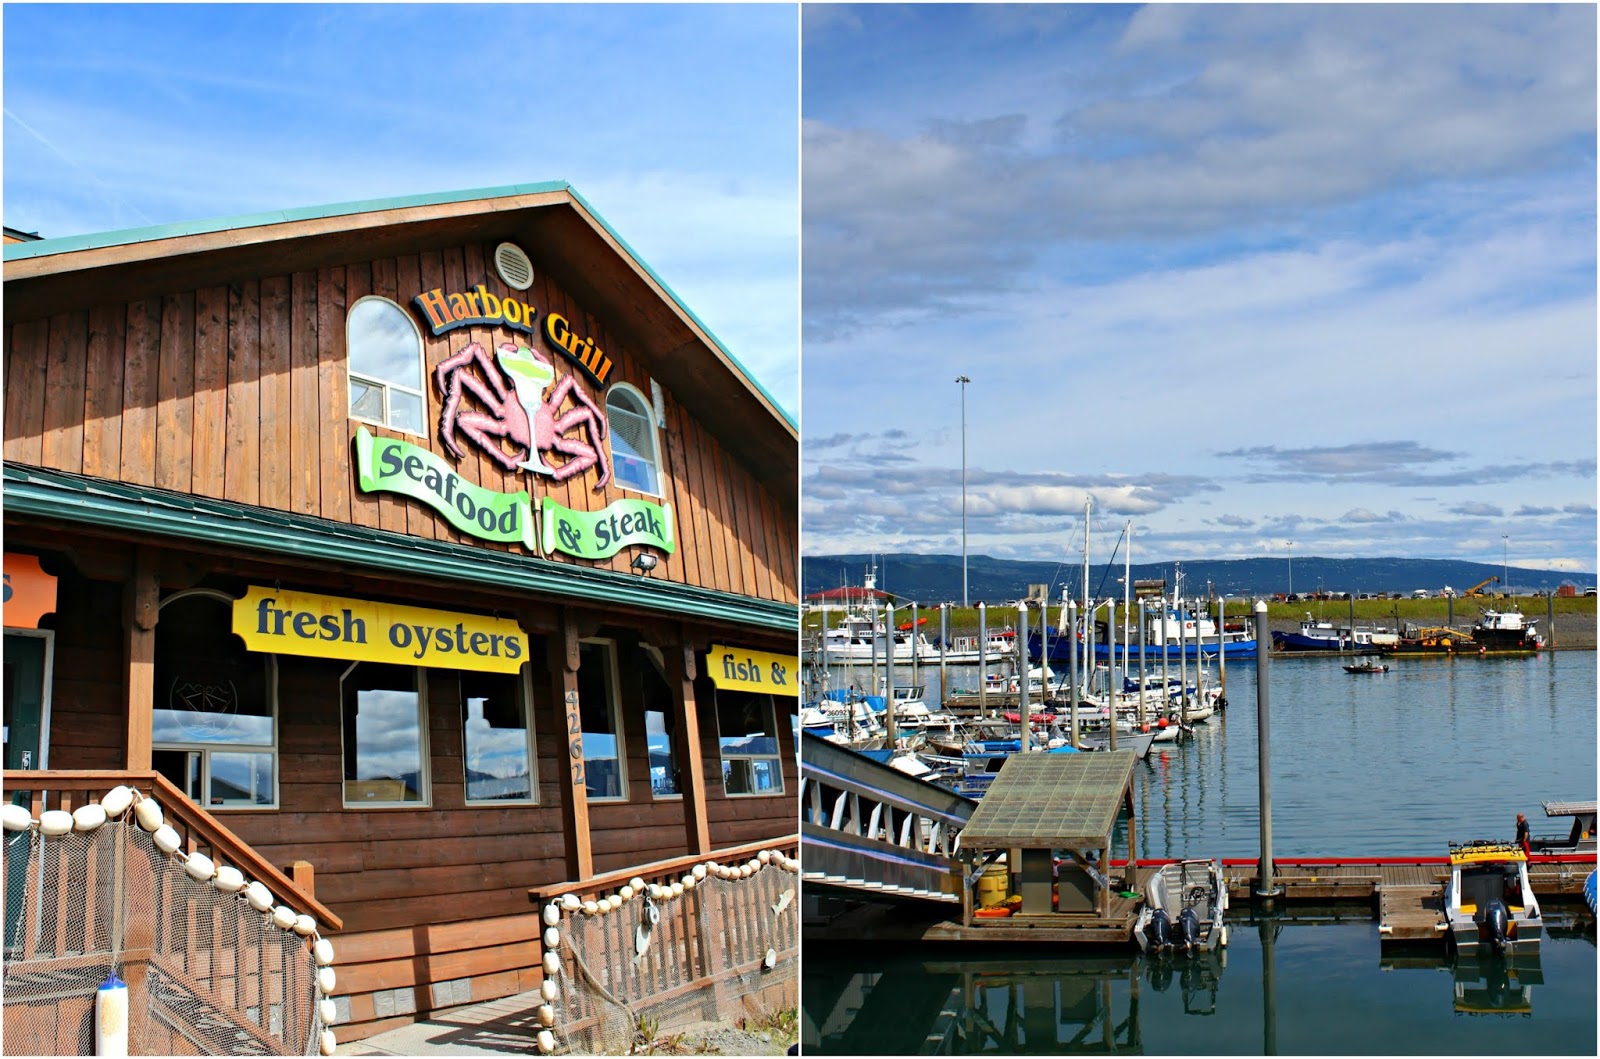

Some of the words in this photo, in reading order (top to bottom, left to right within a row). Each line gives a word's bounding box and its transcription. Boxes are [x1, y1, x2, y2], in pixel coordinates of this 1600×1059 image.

[417, 285, 536, 329] Harbor
[546, 312, 613, 384] Grill
[379, 444, 518, 534] Seafood
[558, 518, 581, 554] &
[595, 507, 665, 550] Steak
[256, 598, 368, 644] fresh
[388, 623, 522, 660] oysters
[722, 653, 762, 683] fish
[771, 661, 787, 686] &
[565, 687, 585, 786] 4262
